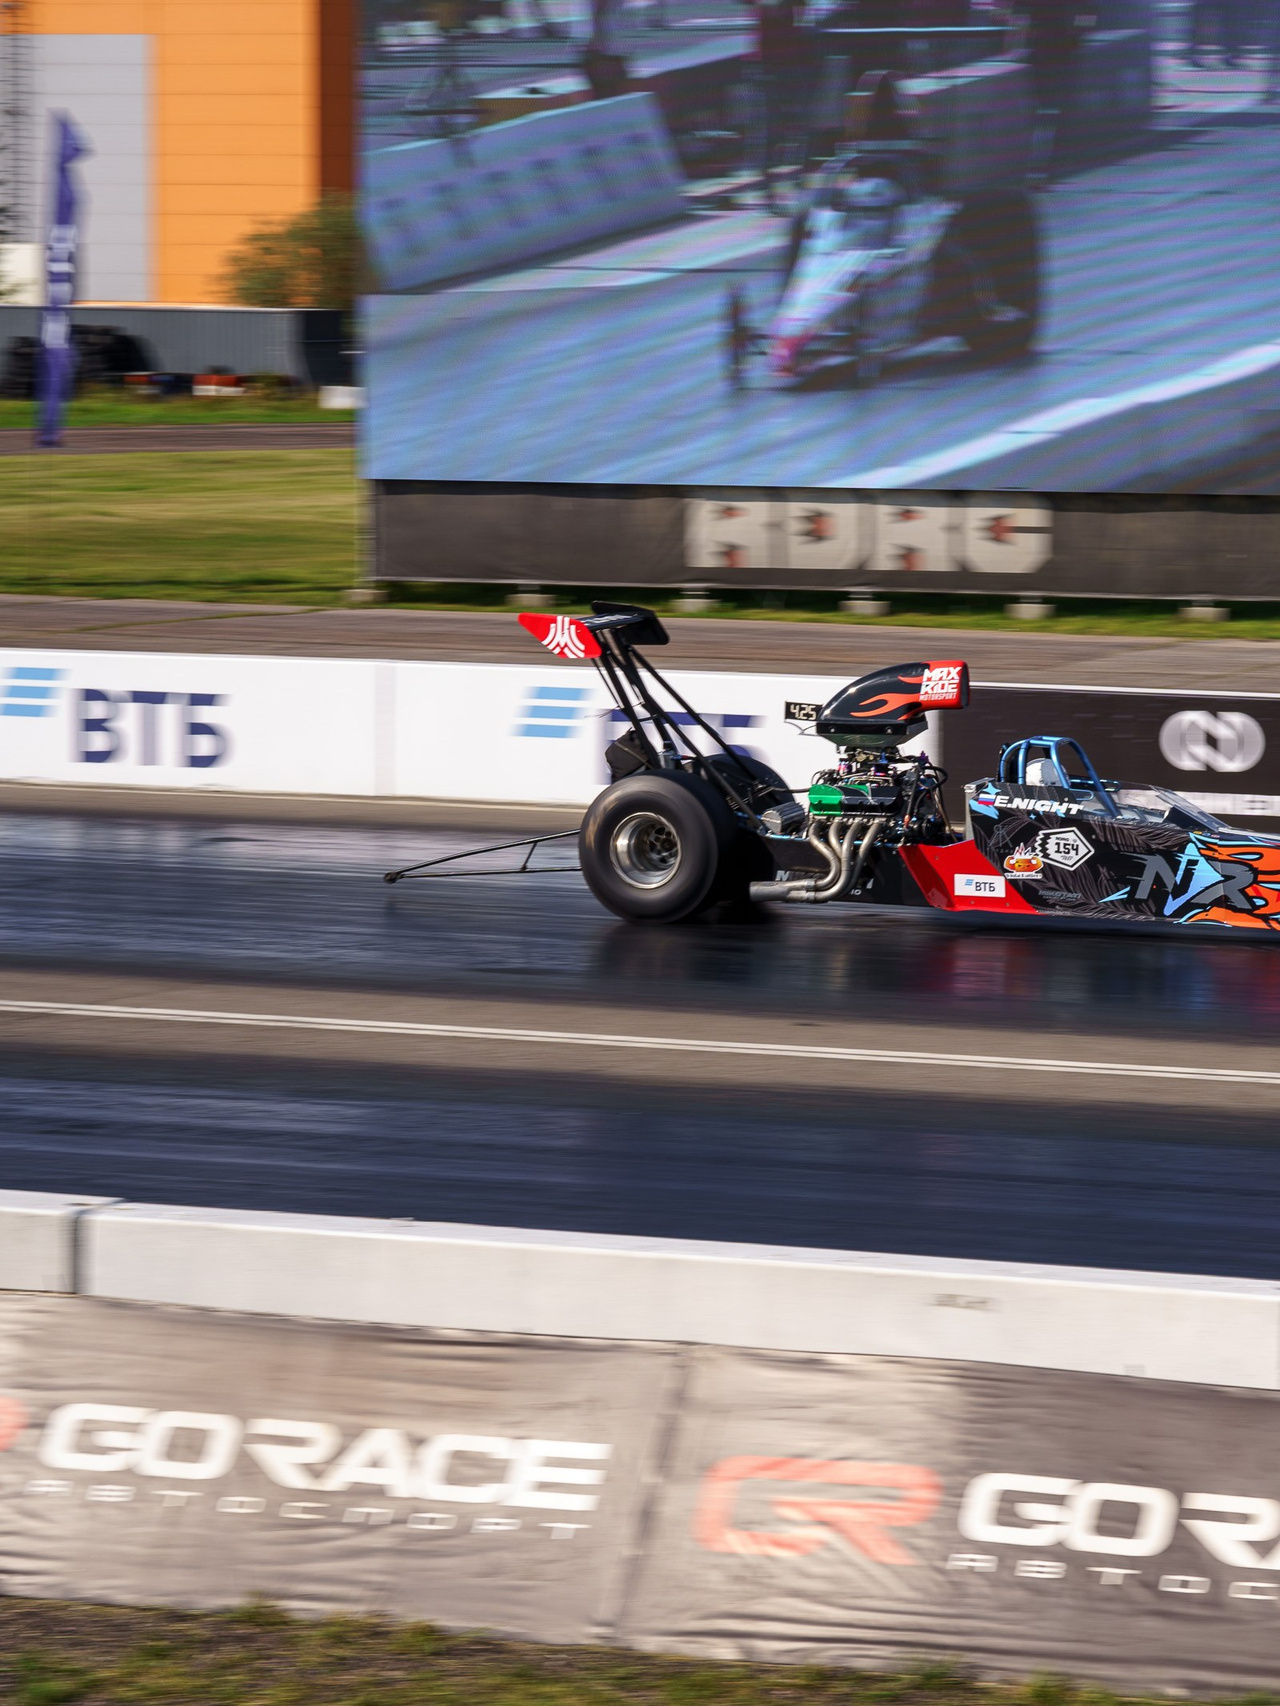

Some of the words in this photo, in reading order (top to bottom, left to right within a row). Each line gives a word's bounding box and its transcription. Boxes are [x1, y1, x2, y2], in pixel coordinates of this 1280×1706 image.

[922, 667, 962, 682] MAX
[920, 680, 959, 694] RIDE
[70, 688, 235, 768] ВТБ
[994, 795, 1085, 815] E.NIGHT
[1054, 842, 1079, 855] 154
[975, 882, 995, 892] ВТБ
[38, 1403, 613, 1511] GORACE
